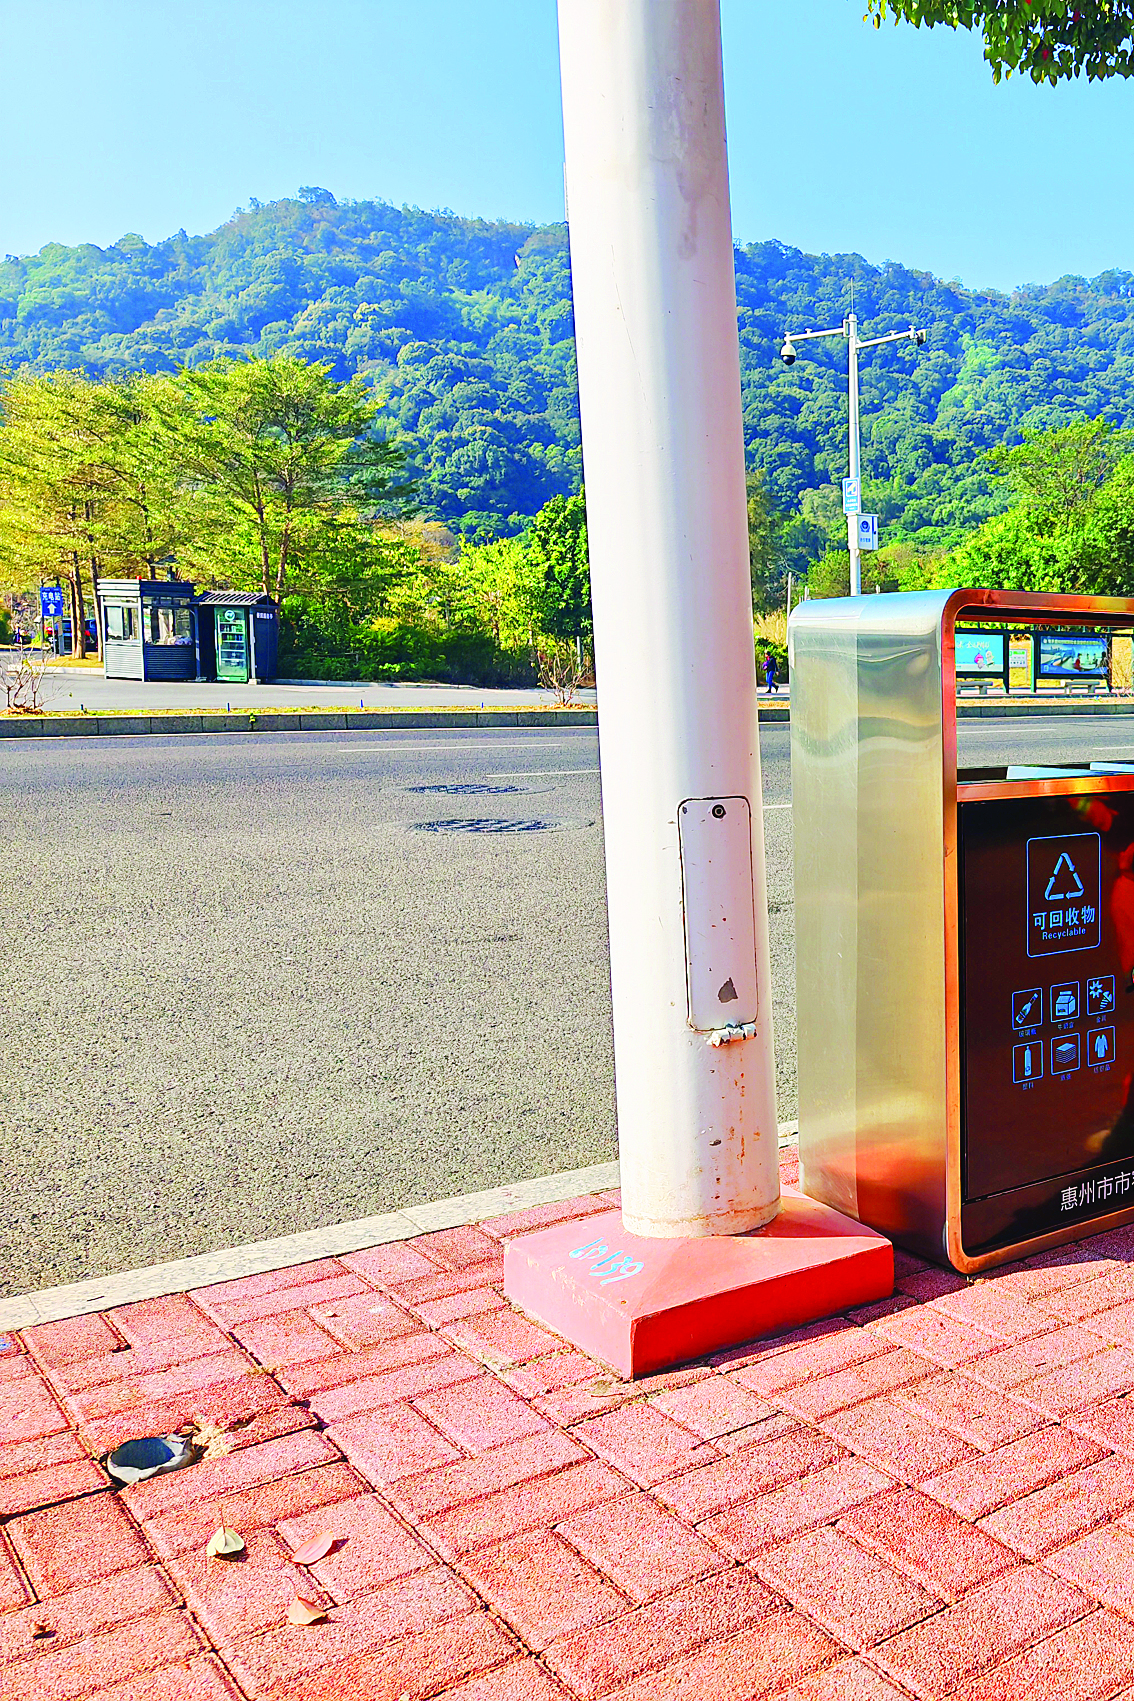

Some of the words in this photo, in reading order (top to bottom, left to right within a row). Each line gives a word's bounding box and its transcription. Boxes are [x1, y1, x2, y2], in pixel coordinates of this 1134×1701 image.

[1032, 905, 1096, 931] 可回收物
[1041, 926, 1087, 941] Recyclable
